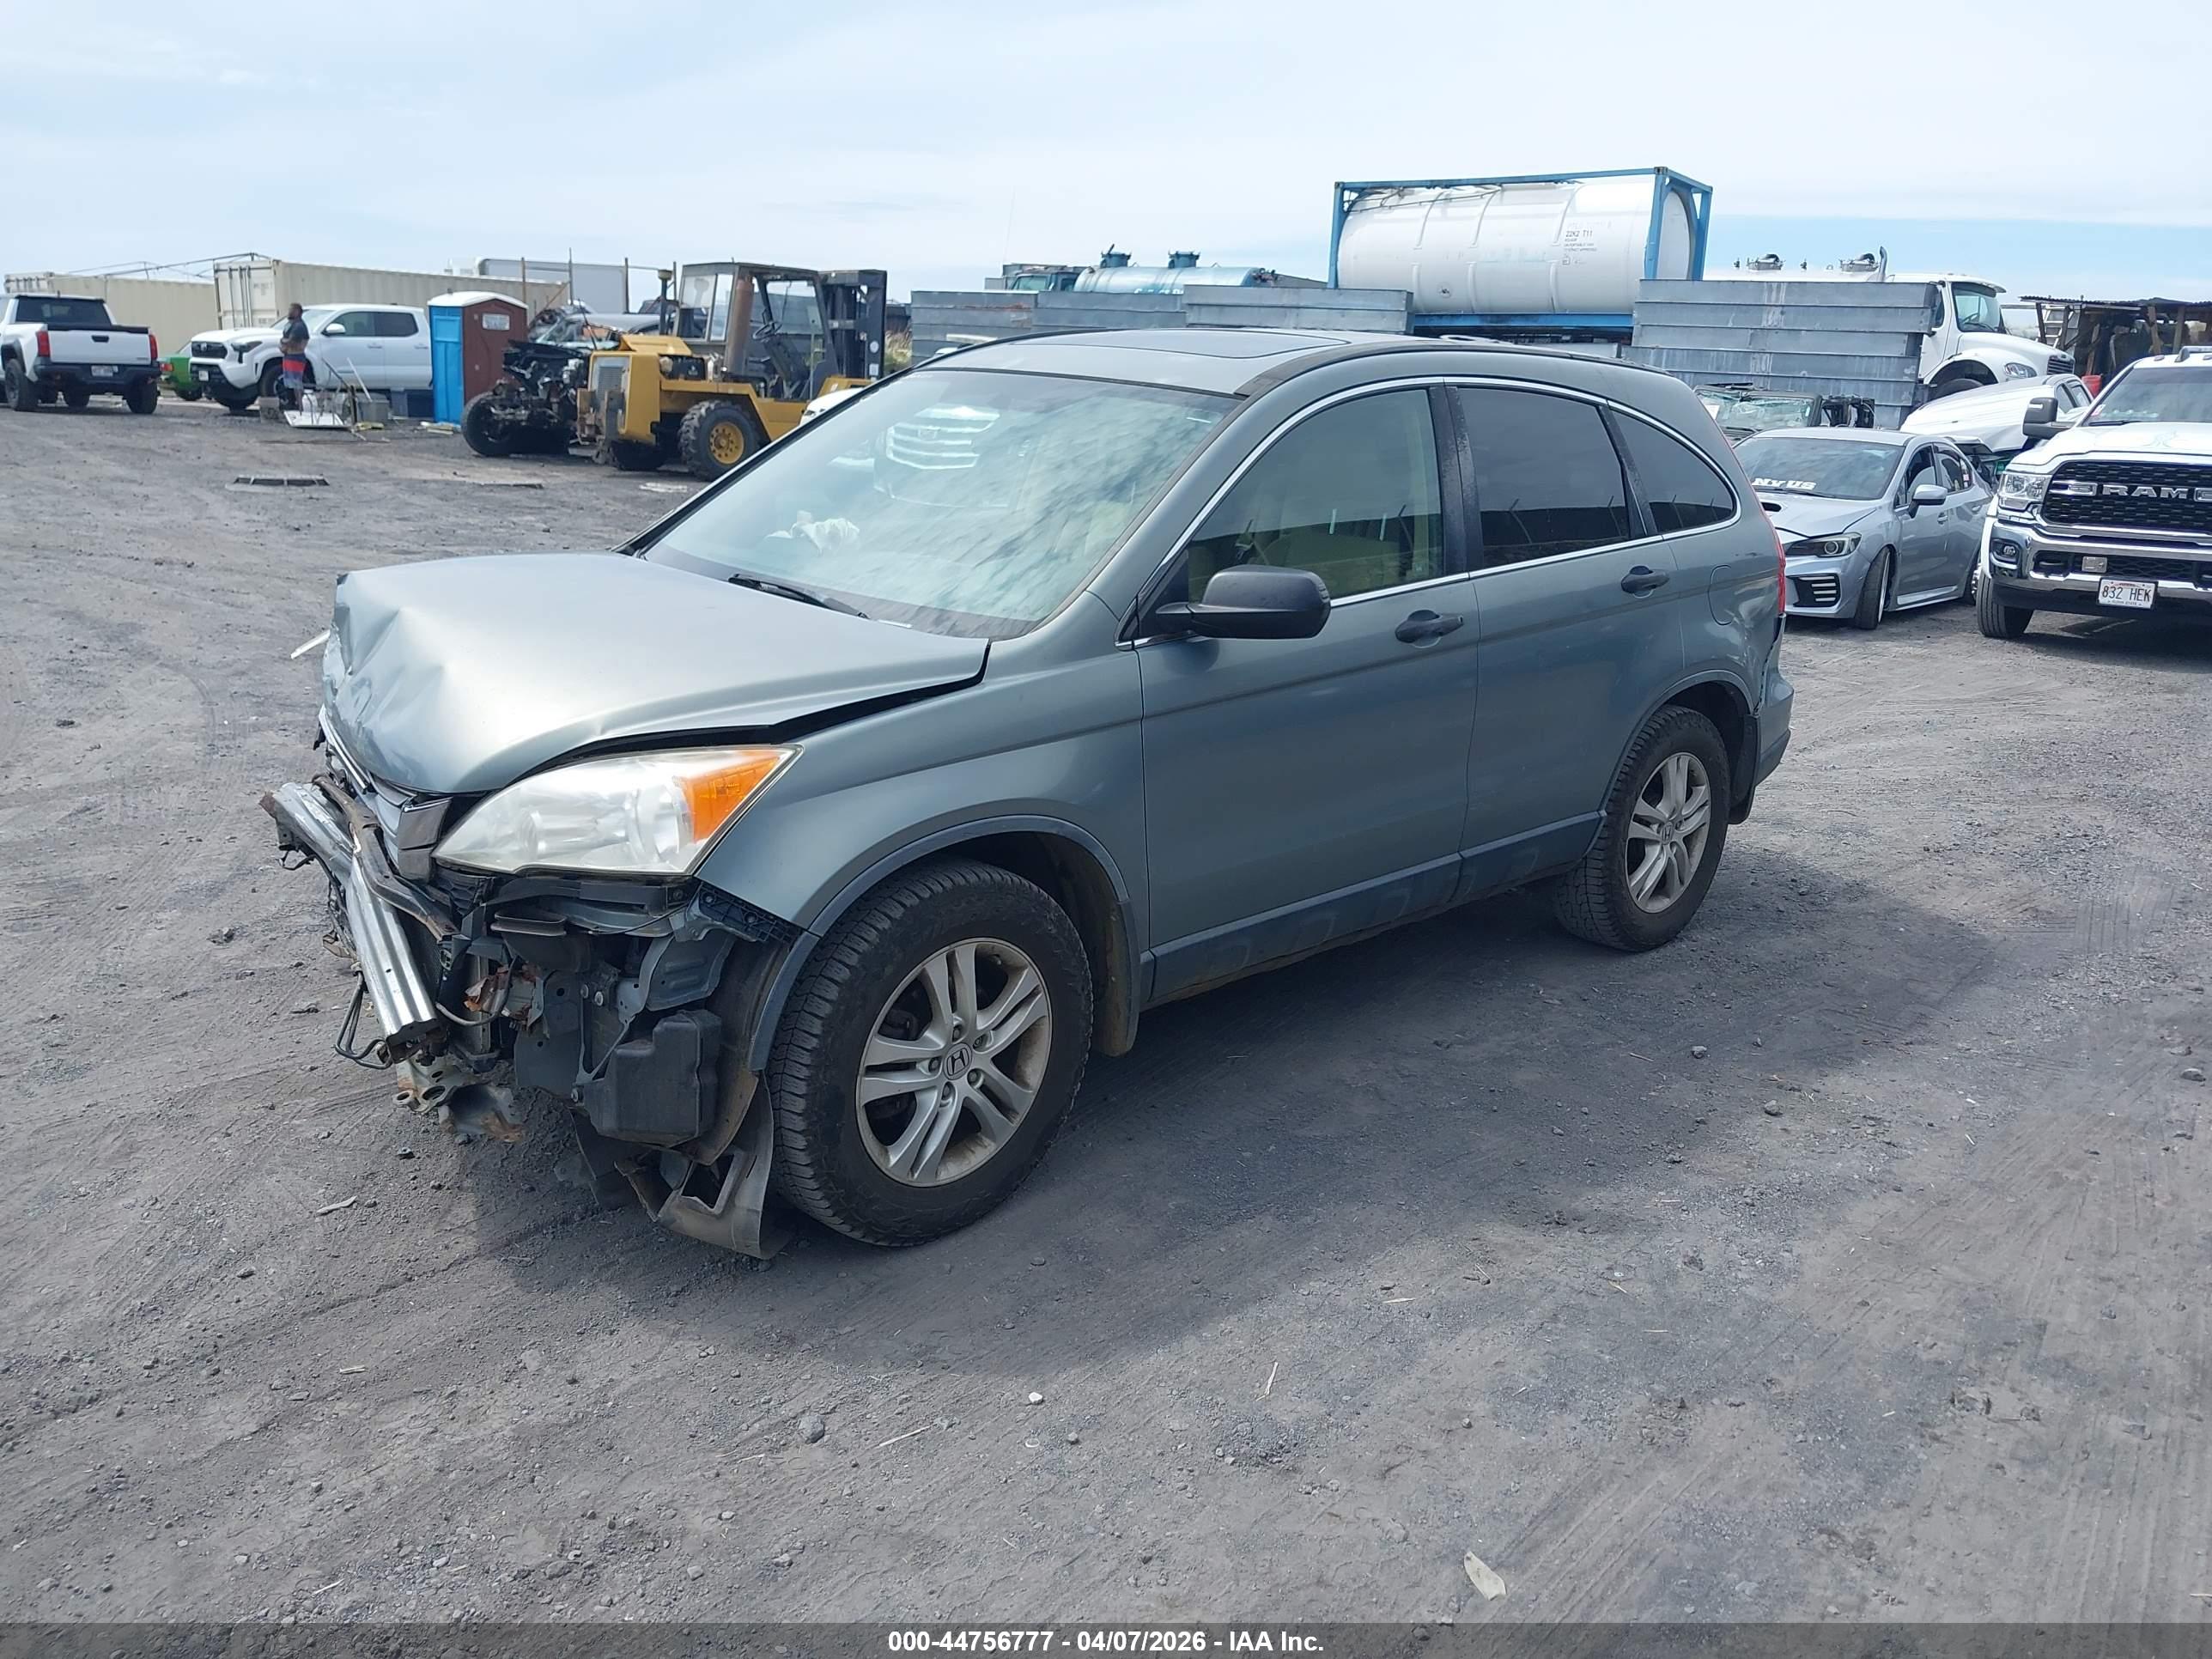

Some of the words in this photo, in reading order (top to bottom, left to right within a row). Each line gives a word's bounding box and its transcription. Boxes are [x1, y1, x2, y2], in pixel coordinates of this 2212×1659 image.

[2102, 484, 2189, 499] RAM
[2102, 585, 2124, 599] 832
[2129, 587, 2152, 602] HEK
